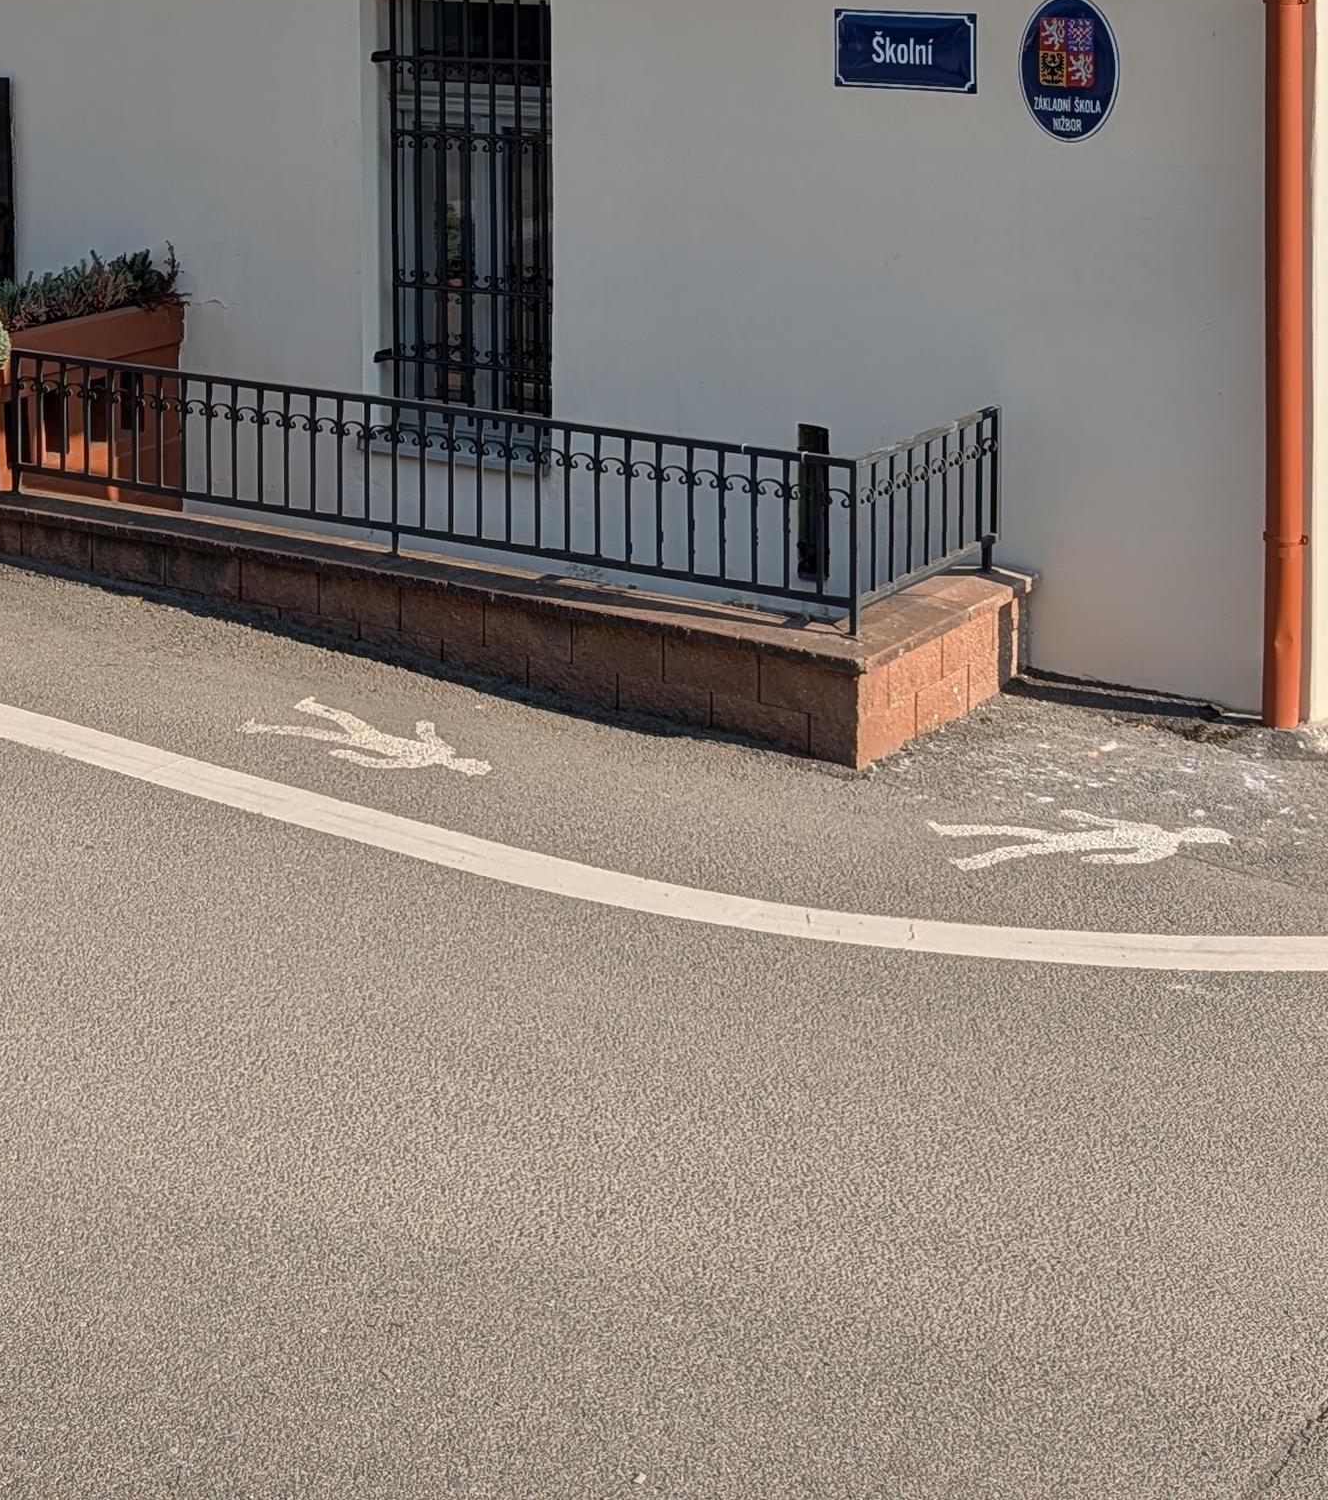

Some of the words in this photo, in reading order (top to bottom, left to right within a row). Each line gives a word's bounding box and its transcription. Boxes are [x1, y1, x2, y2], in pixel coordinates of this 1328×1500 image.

[872, 31, 933, 66] Školní
[1033, 96, 1072, 113] ZÁKLADNÍ
[1073, 97, 1102, 114] ŠKOLA
[1052, 116, 1083, 133] NIŽBOR
